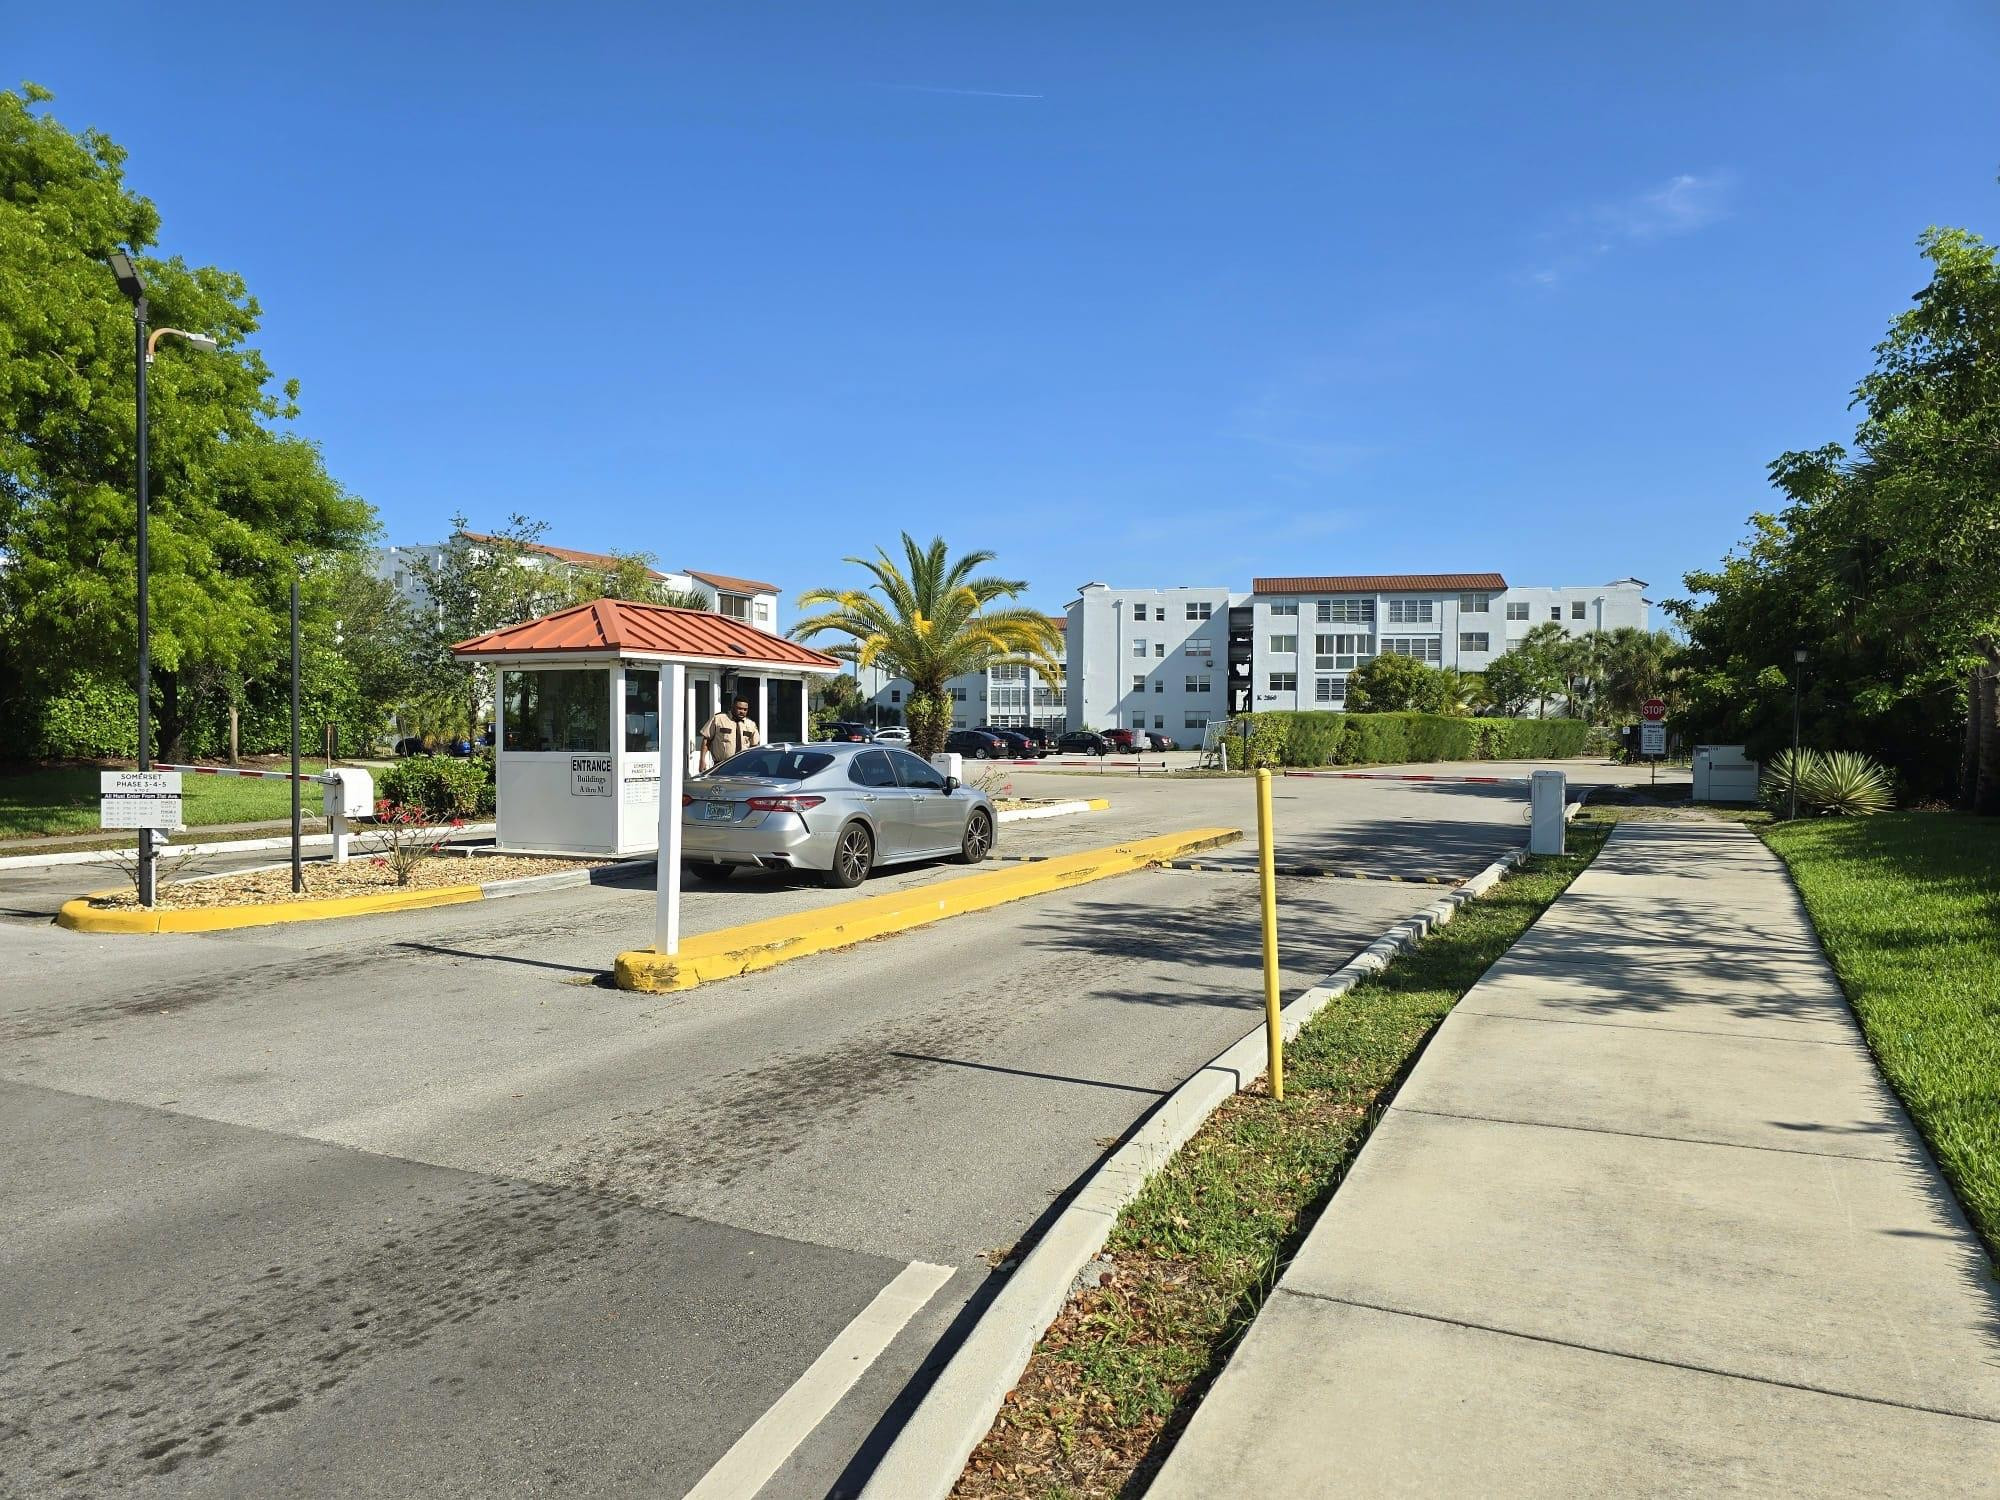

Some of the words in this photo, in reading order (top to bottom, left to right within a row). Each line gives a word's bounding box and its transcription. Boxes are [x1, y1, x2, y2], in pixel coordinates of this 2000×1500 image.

[1643, 706, 1665, 715] STOP
[572, 760, 611, 772] ENTRANCE
[577, 775, 606, 785] Buildings
